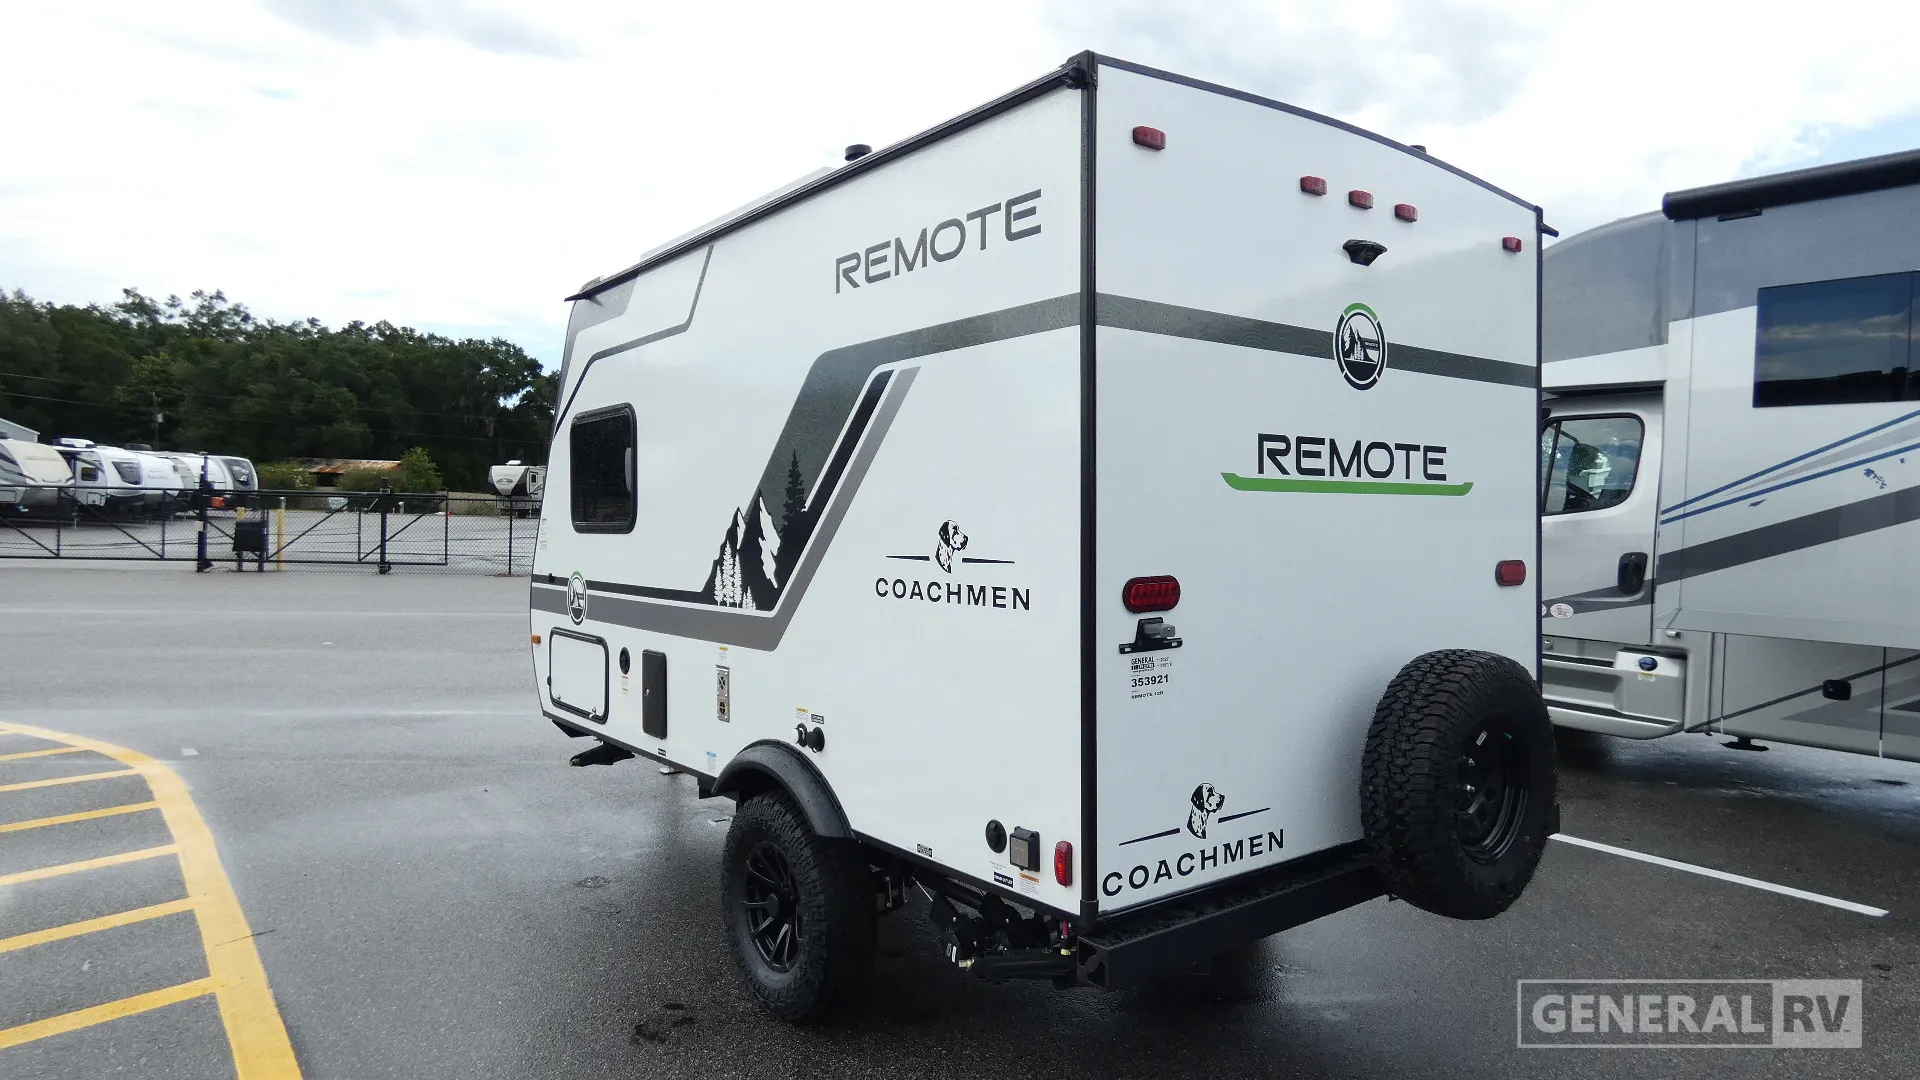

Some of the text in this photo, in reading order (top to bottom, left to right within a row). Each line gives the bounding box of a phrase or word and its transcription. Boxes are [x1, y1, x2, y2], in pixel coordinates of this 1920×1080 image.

[836, 189, 1042, 294] REMOTE
[1258, 433, 1447, 481] REMOTE
[876, 577, 1030, 611] COACHMEN
[1131, 656, 1155, 665] GENERAL
[1131, 673, 1169, 688] 353921
[1102, 828, 1284, 898] COACHMEN
